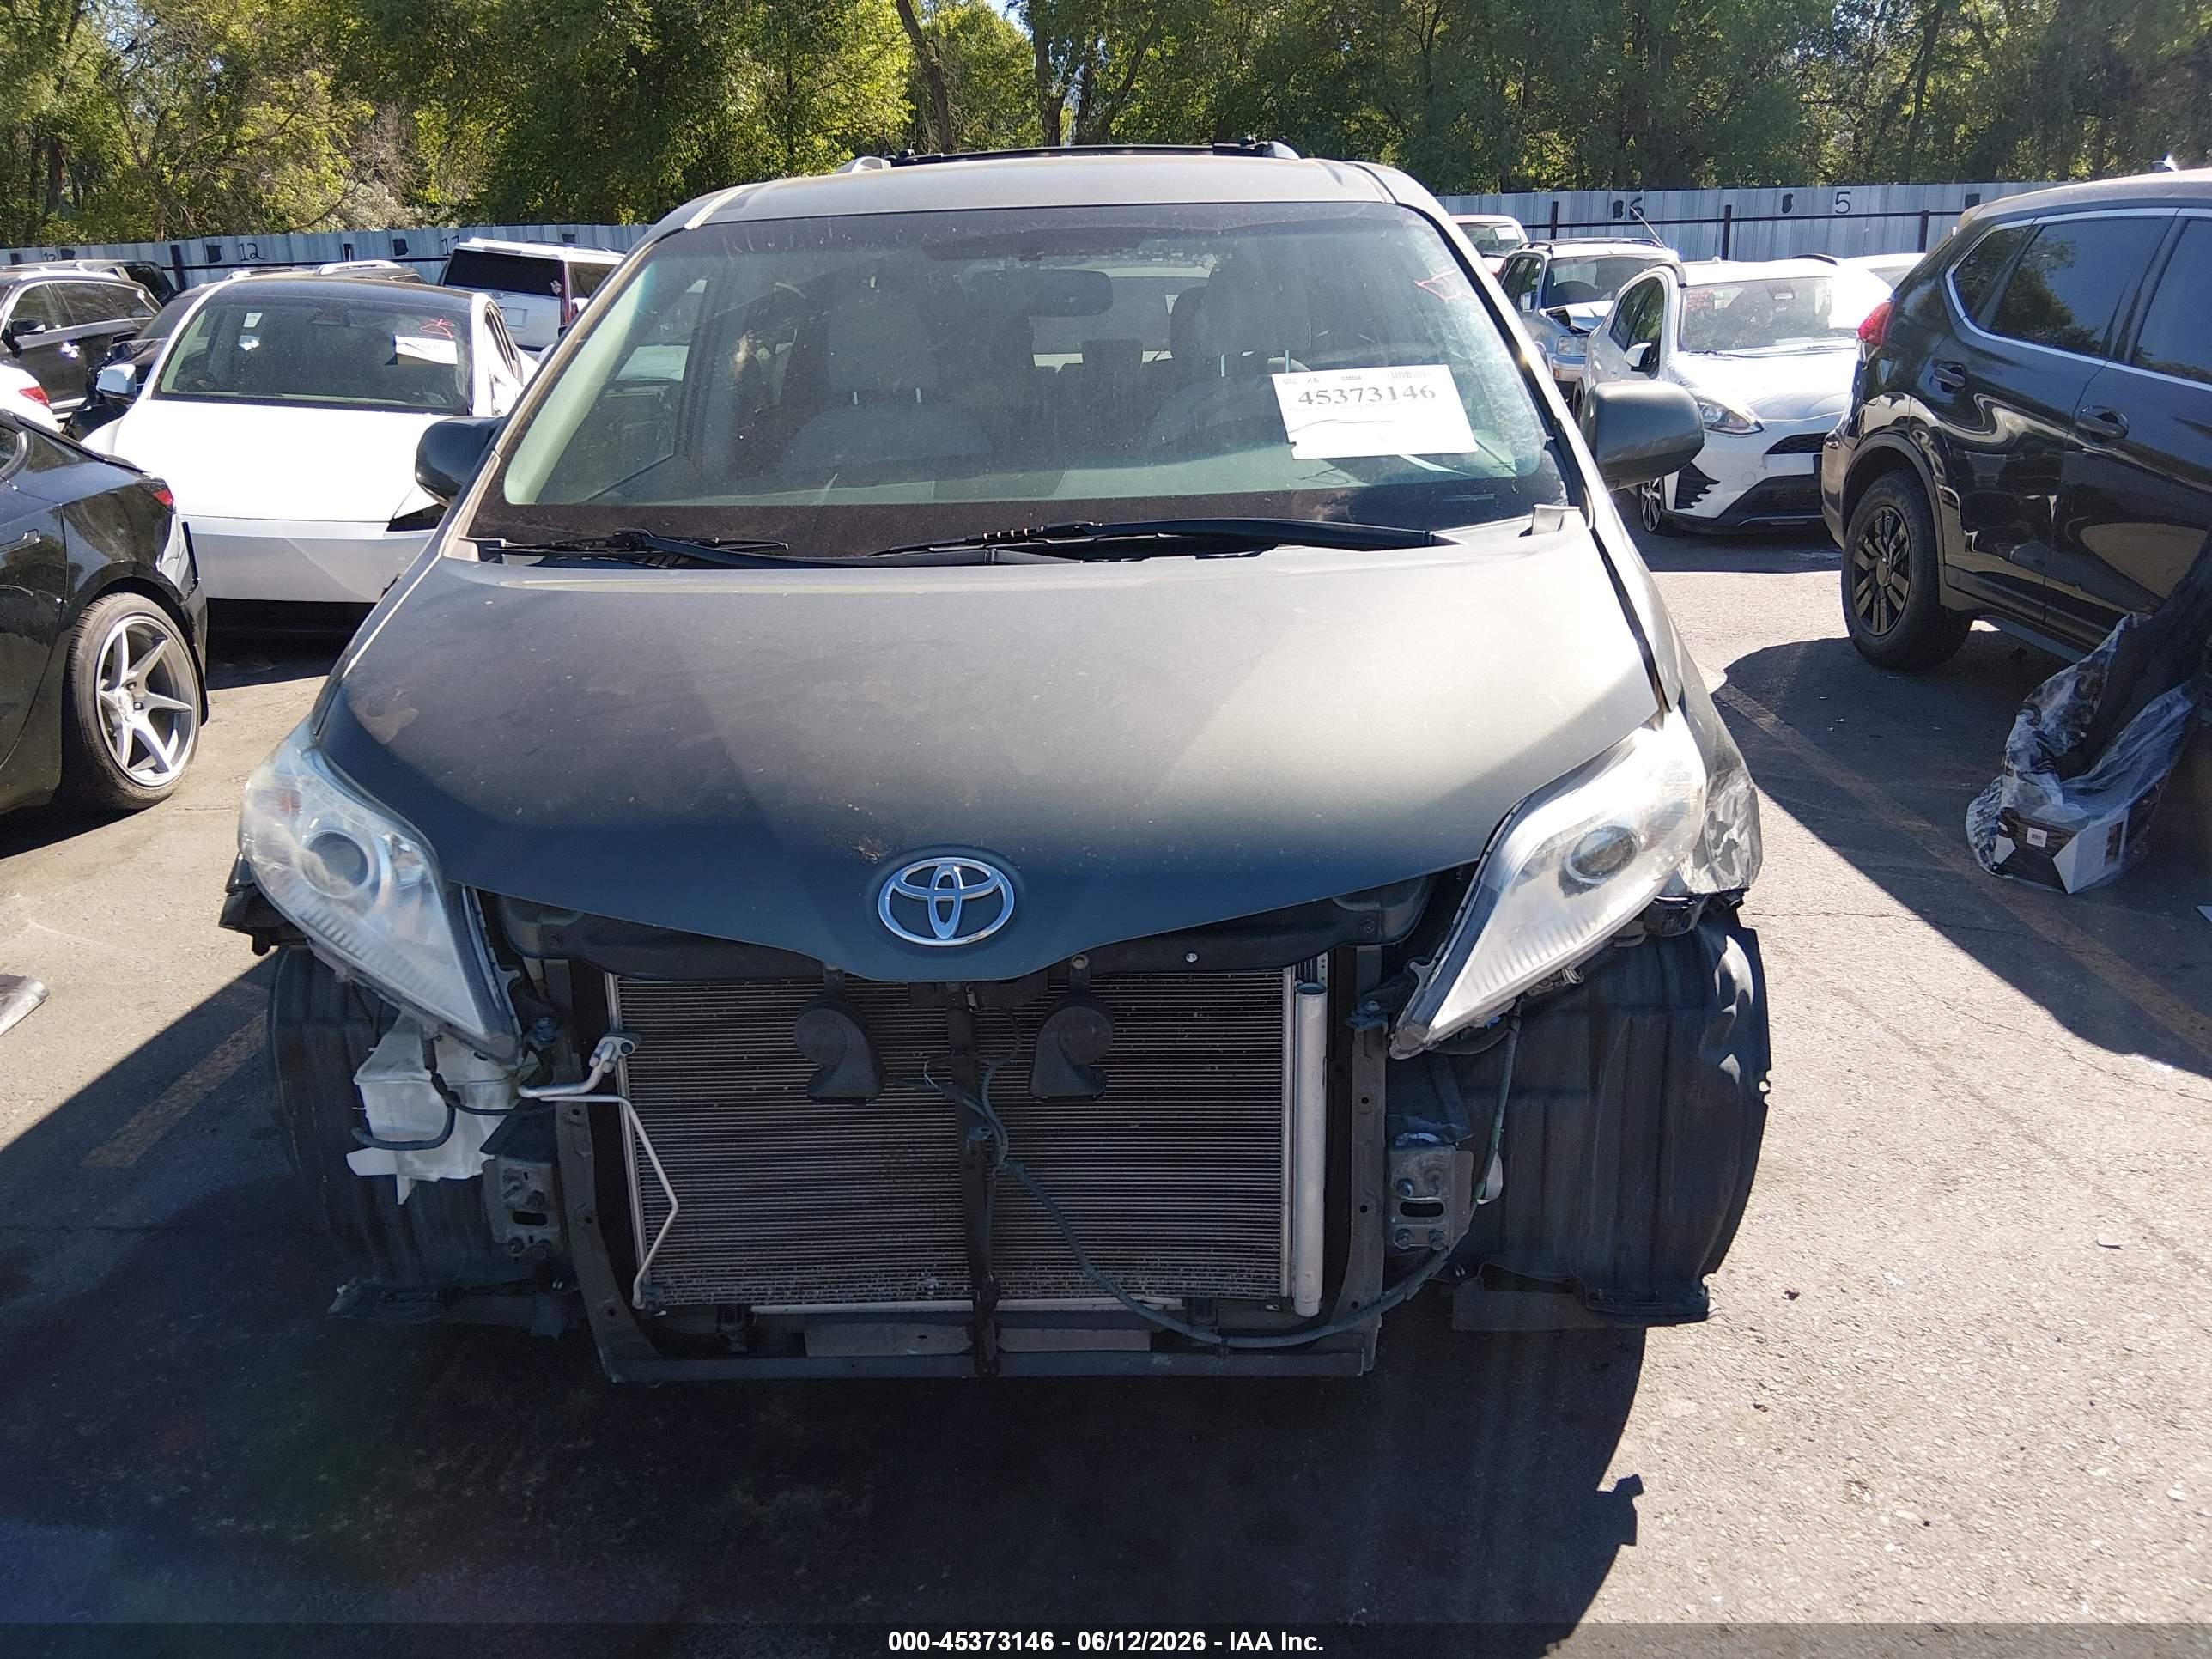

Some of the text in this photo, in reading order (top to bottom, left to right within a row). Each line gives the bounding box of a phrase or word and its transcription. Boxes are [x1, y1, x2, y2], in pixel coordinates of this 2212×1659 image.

[1629, 198, 1644, 220] 6
[1835, 191, 1851, 214] 5
[239, 243, 266, 261] 12
[1297, 384, 1437, 405] 45373146
